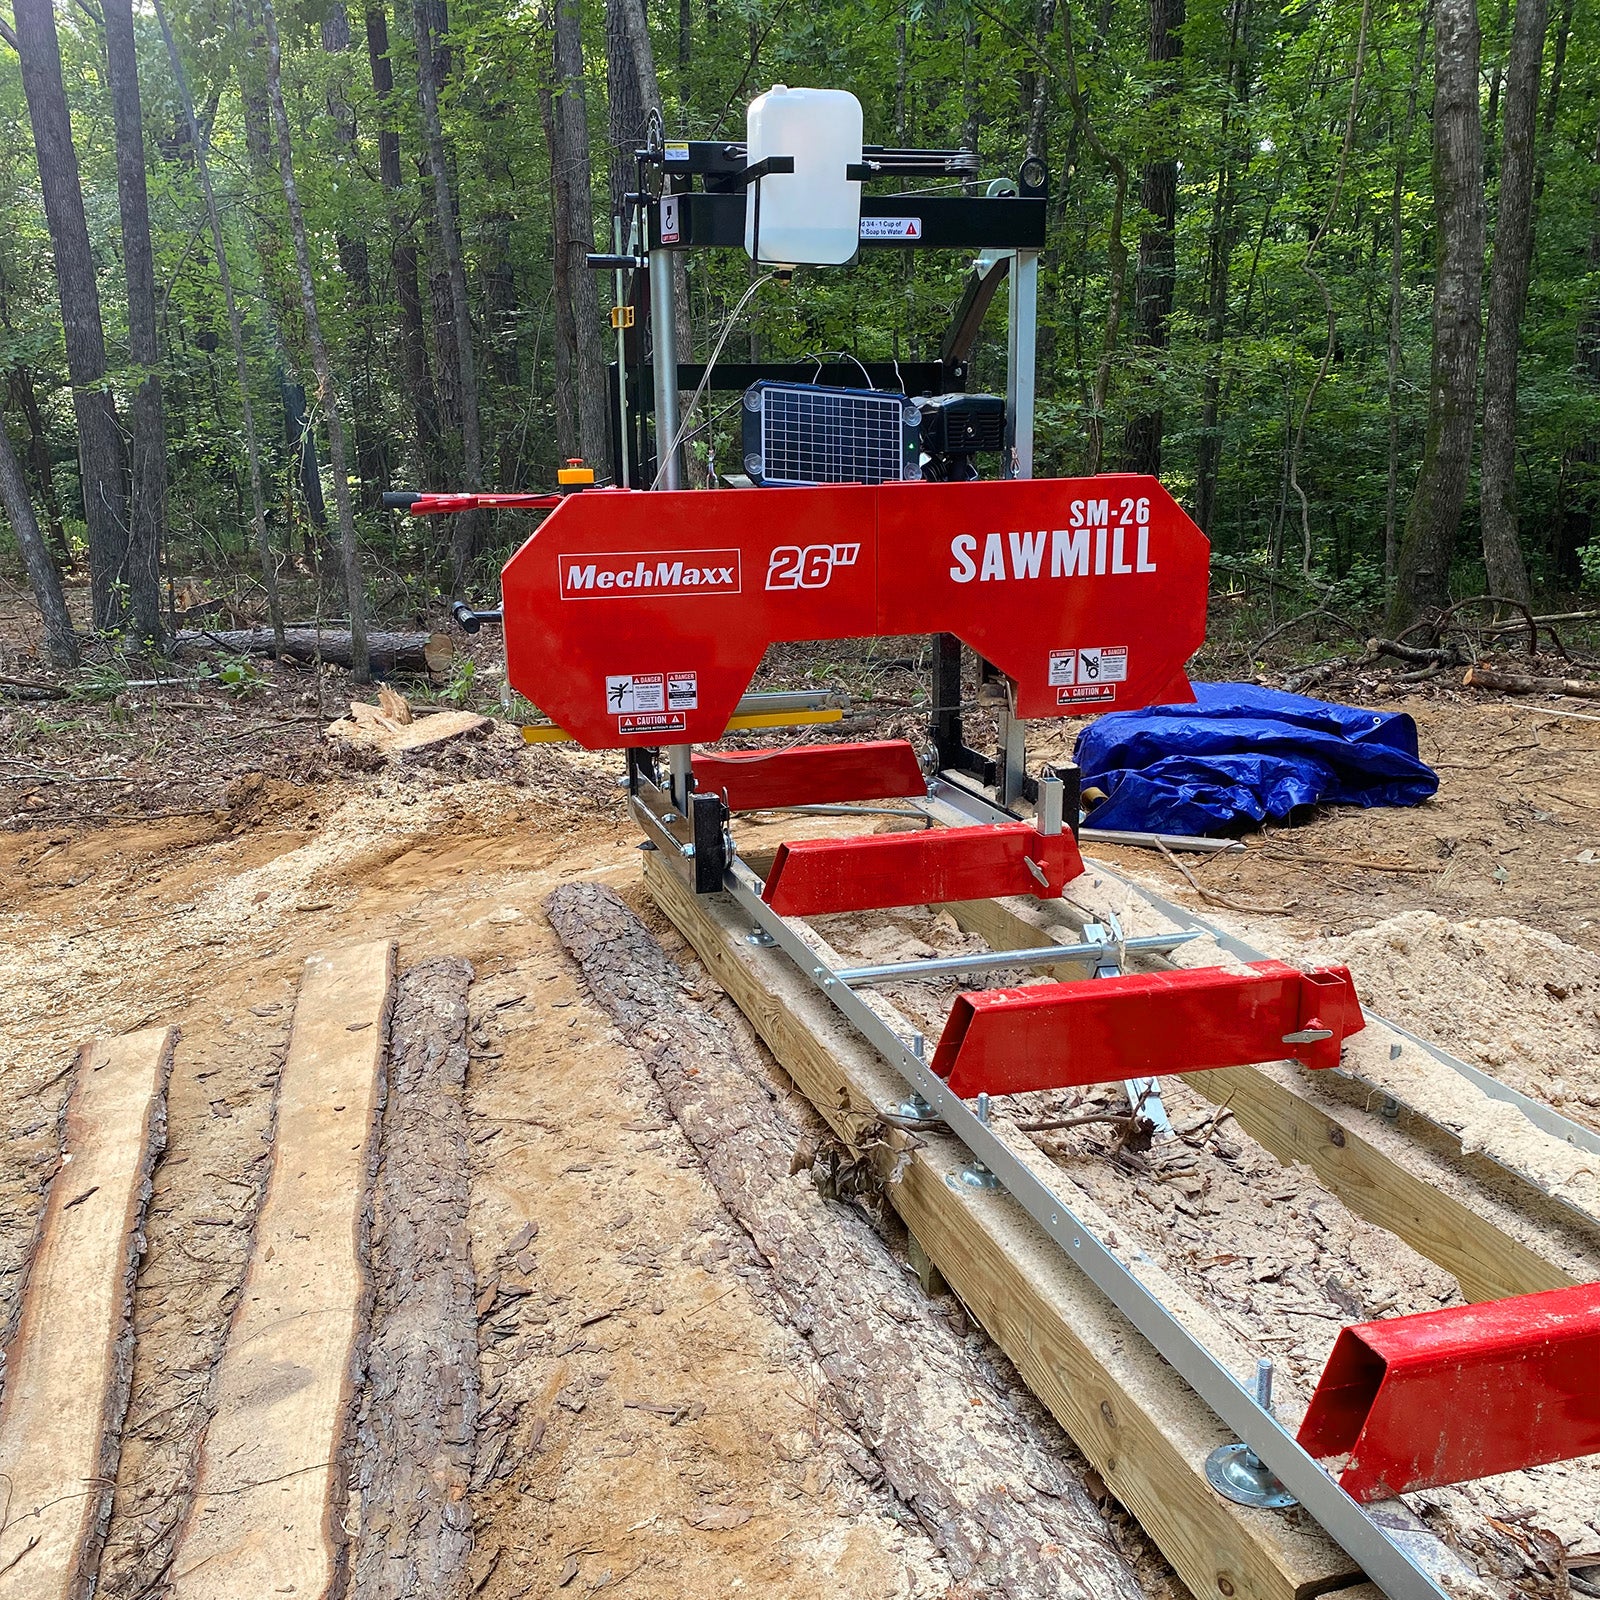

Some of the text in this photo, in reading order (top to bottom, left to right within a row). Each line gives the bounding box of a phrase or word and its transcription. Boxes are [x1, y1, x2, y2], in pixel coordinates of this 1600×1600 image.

[1069, 498, 1150, 527] SM-26
[765, 543, 860, 591] 26"
[950, 526, 1156, 583] SAWMILL
[567, 562, 734, 590] MechMaxx
[1072, 687, 1099, 696] CAUTION
[636, 715, 667, 725] CAUTION
